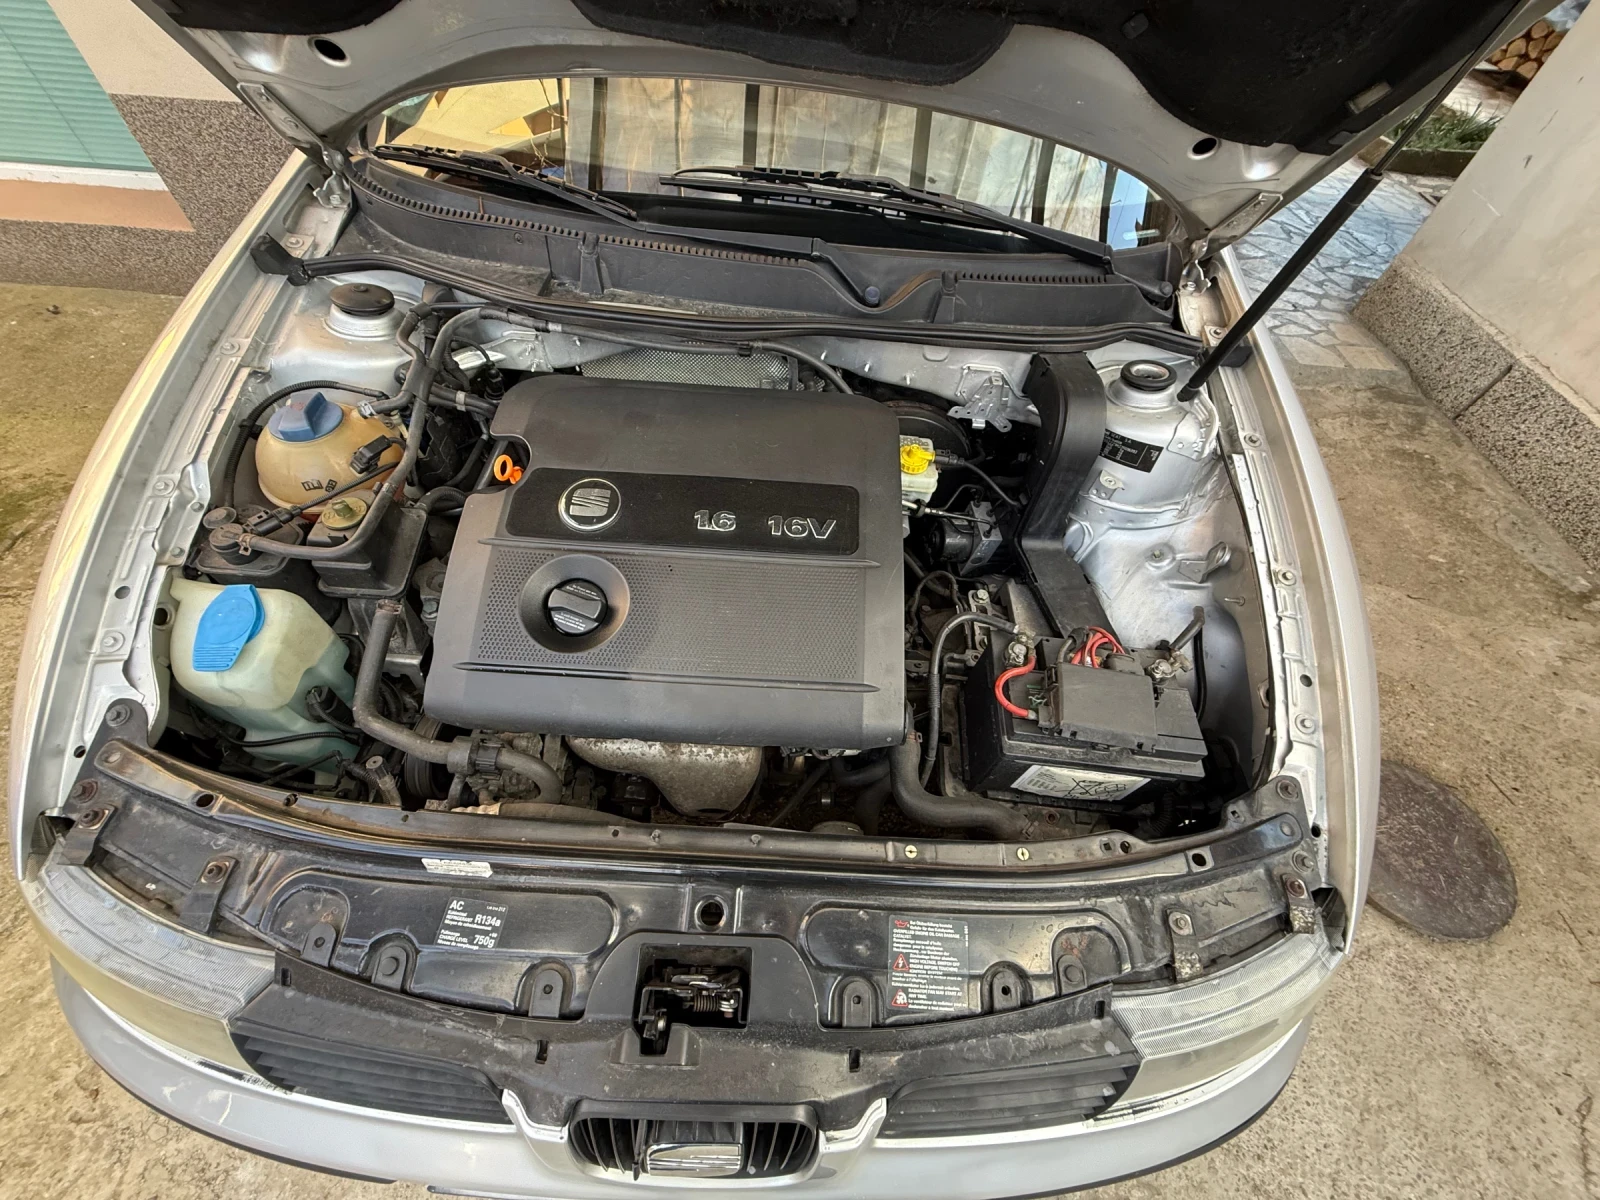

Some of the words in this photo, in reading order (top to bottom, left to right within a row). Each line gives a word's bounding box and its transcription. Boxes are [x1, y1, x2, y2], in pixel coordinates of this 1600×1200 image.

[768, 515, 836, 539] 16V
[449, 900, 464, 910] AC
[474, 914, 501, 926] R134a
[473, 935, 495, 948] 750g
